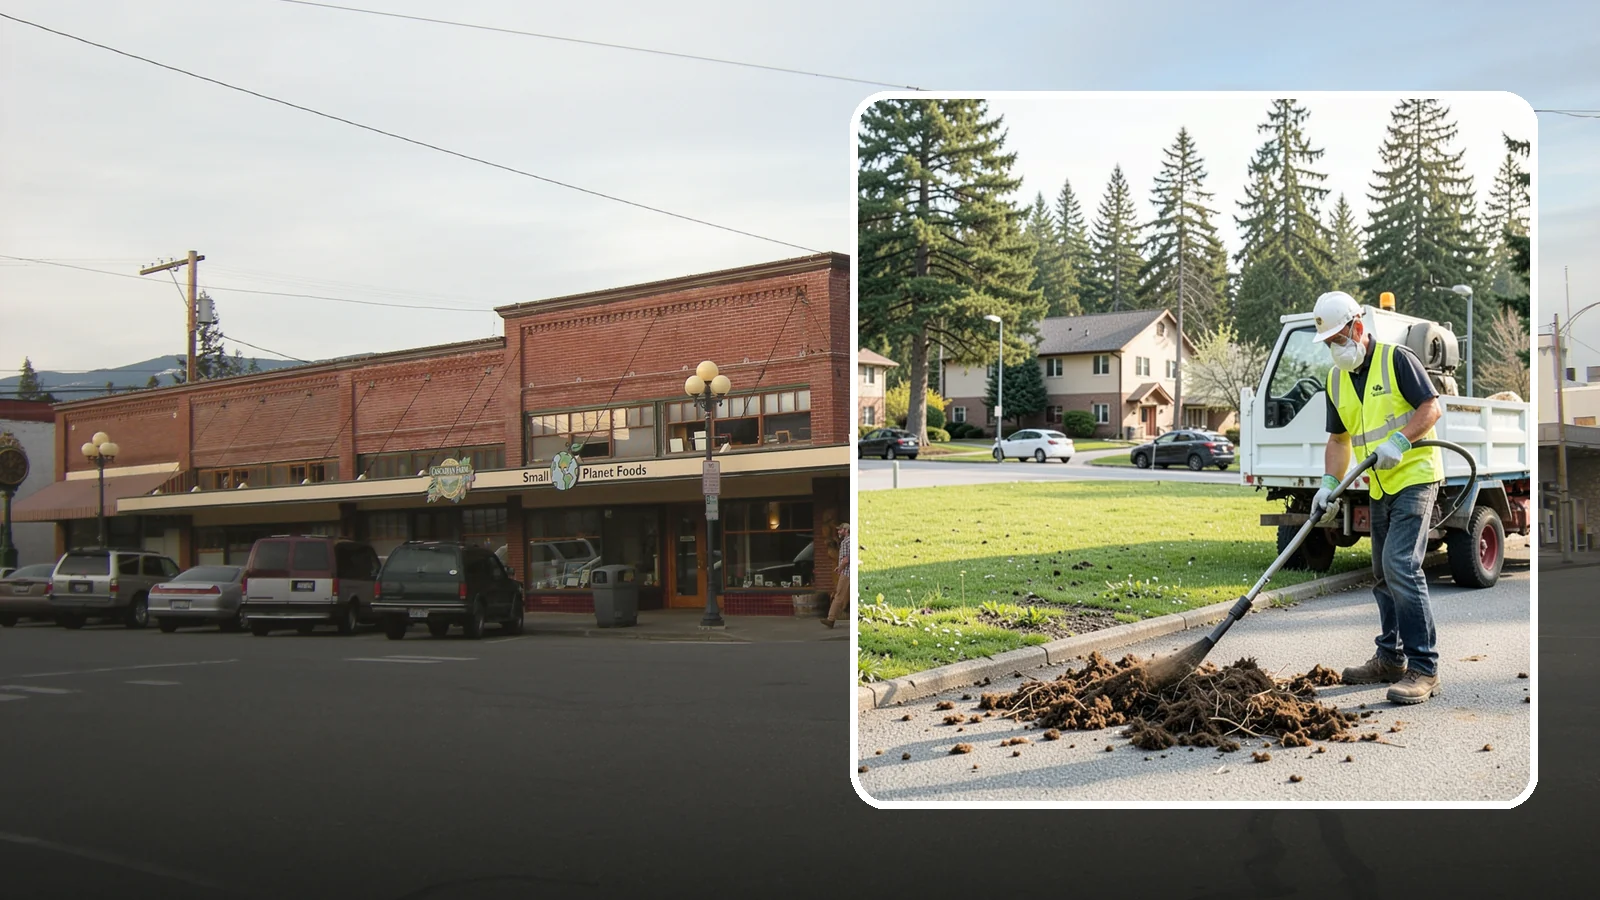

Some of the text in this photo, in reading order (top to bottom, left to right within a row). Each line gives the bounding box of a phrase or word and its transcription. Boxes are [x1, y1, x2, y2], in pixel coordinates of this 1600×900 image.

[523, 464, 647, 483] Small Planet Foods
